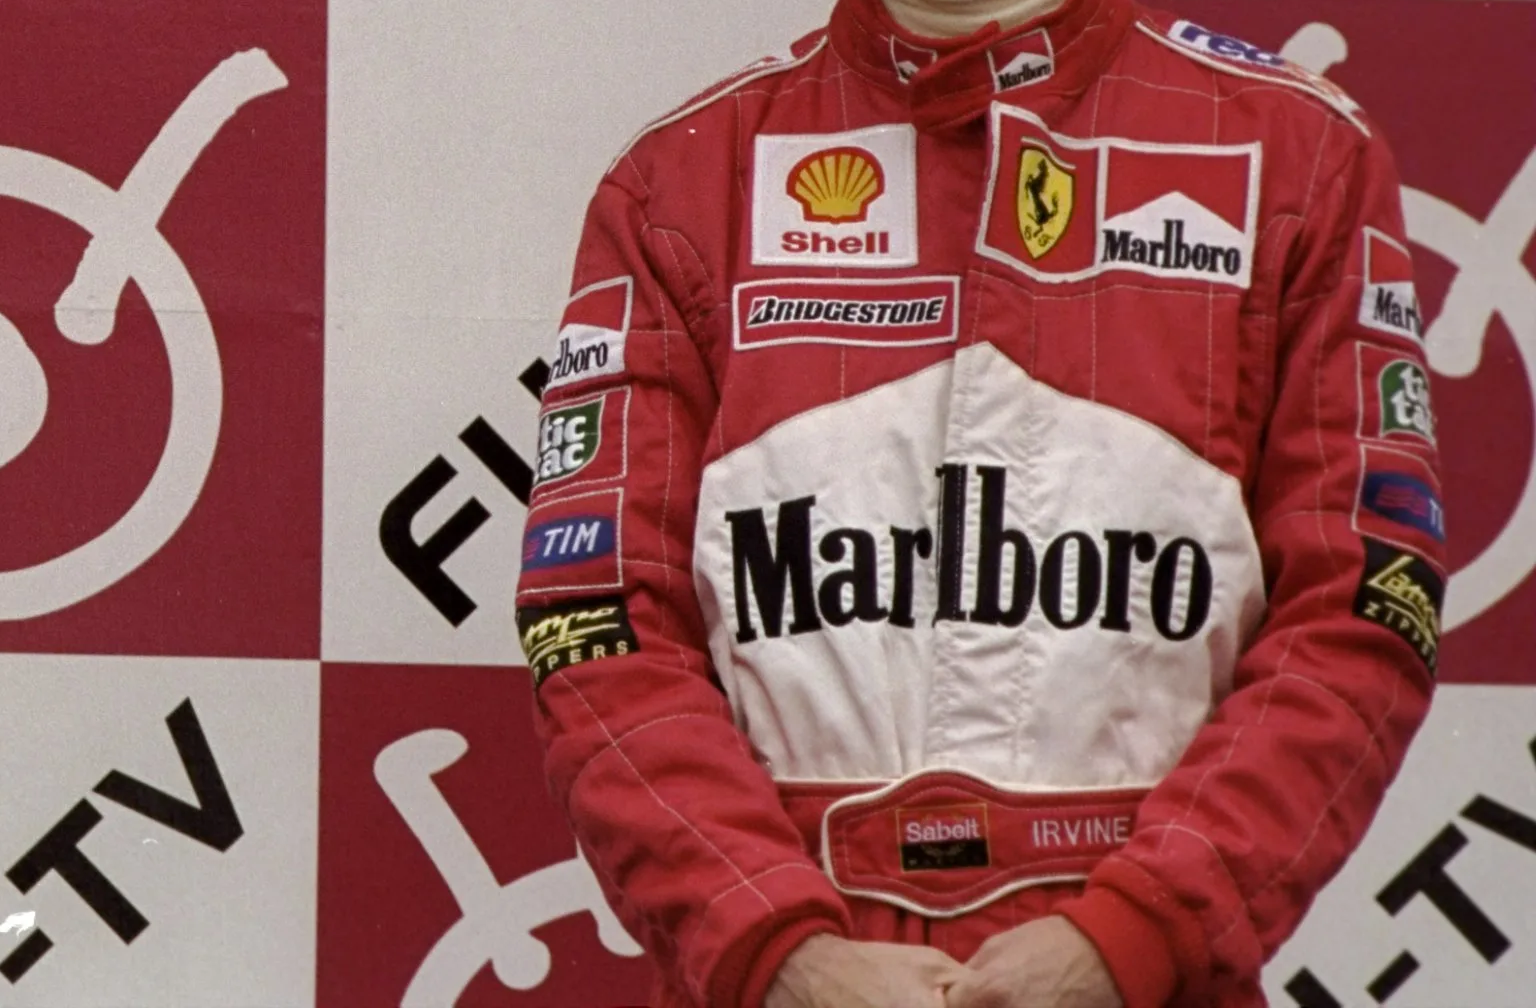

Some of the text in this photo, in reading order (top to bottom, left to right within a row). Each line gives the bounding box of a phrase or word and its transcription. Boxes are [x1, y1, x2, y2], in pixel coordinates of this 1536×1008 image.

[781, 231, 890, 254] Shell
[1101, 219, 1241, 276] Marlboro
[747, 295, 946, 330] BRIDGESTONE
[543, 520, 601, 558] TIM
[725, 462, 1213, 645] Marlboro
[906, 816, 981, 843] Sabelt
[1031, 815, 1132, 847] IRVINE
